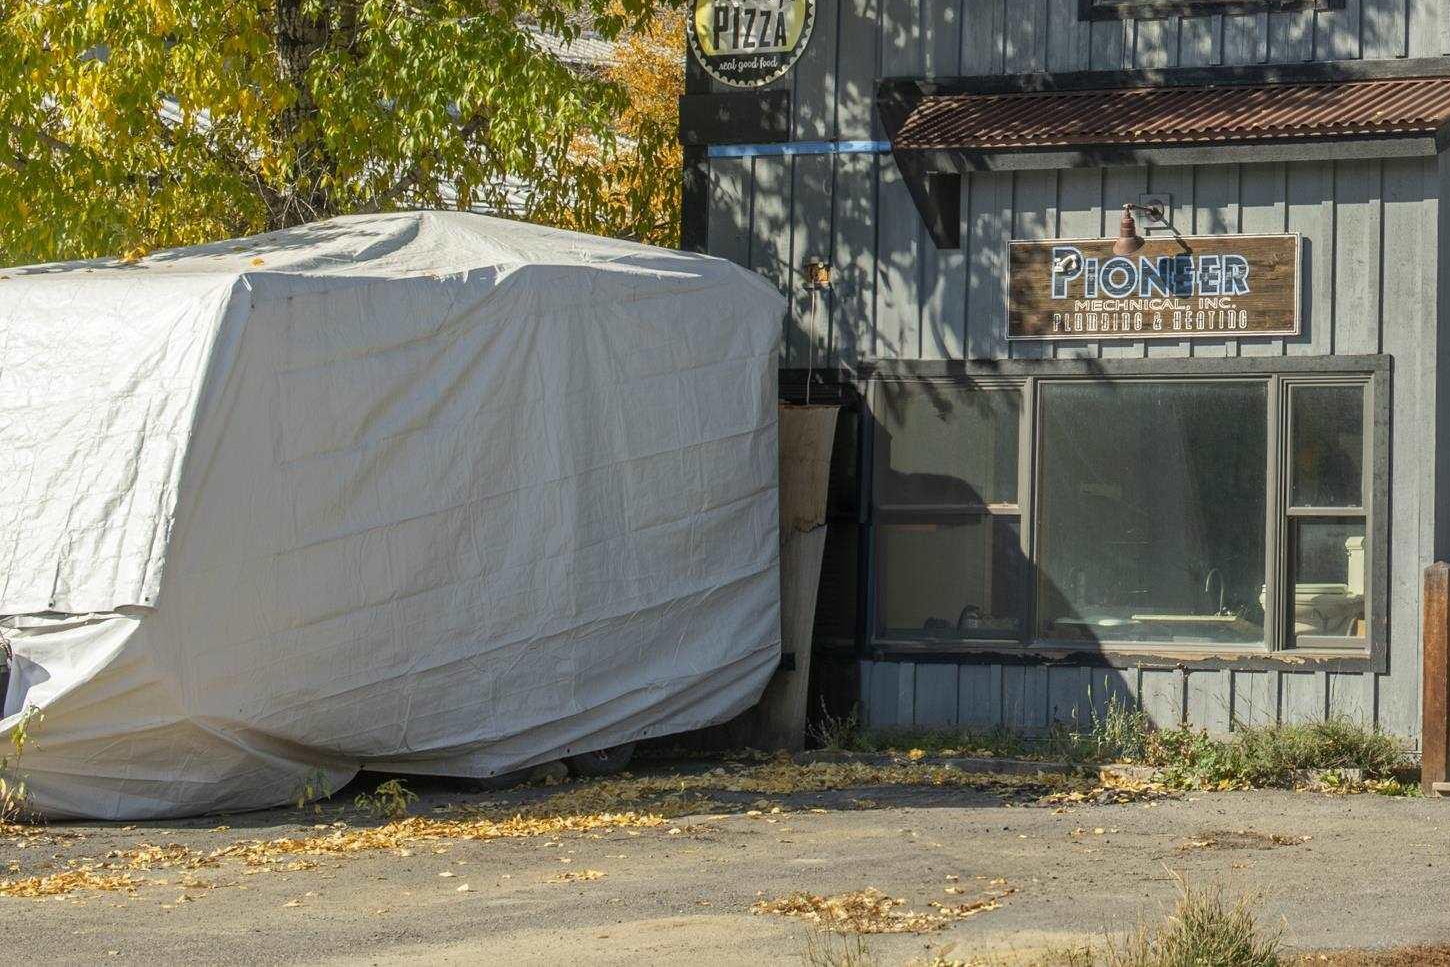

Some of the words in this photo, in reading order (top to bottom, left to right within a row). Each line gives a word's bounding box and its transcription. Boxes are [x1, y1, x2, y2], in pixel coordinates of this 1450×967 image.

[713, 5, 788, 51] PIZZA
[738, 56, 759, 73] good
[760, 55, 778, 69] food
[1051, 245, 1250, 299] PIONEER
[1074, 298, 1191, 312] MECHNICAL,
[1198, 297, 1237, 309] INC.
[1053, 312, 1143, 332] PLUMBING
[1152, 311, 1163, 331] &
[1172, 309, 1248, 330] HEATING
